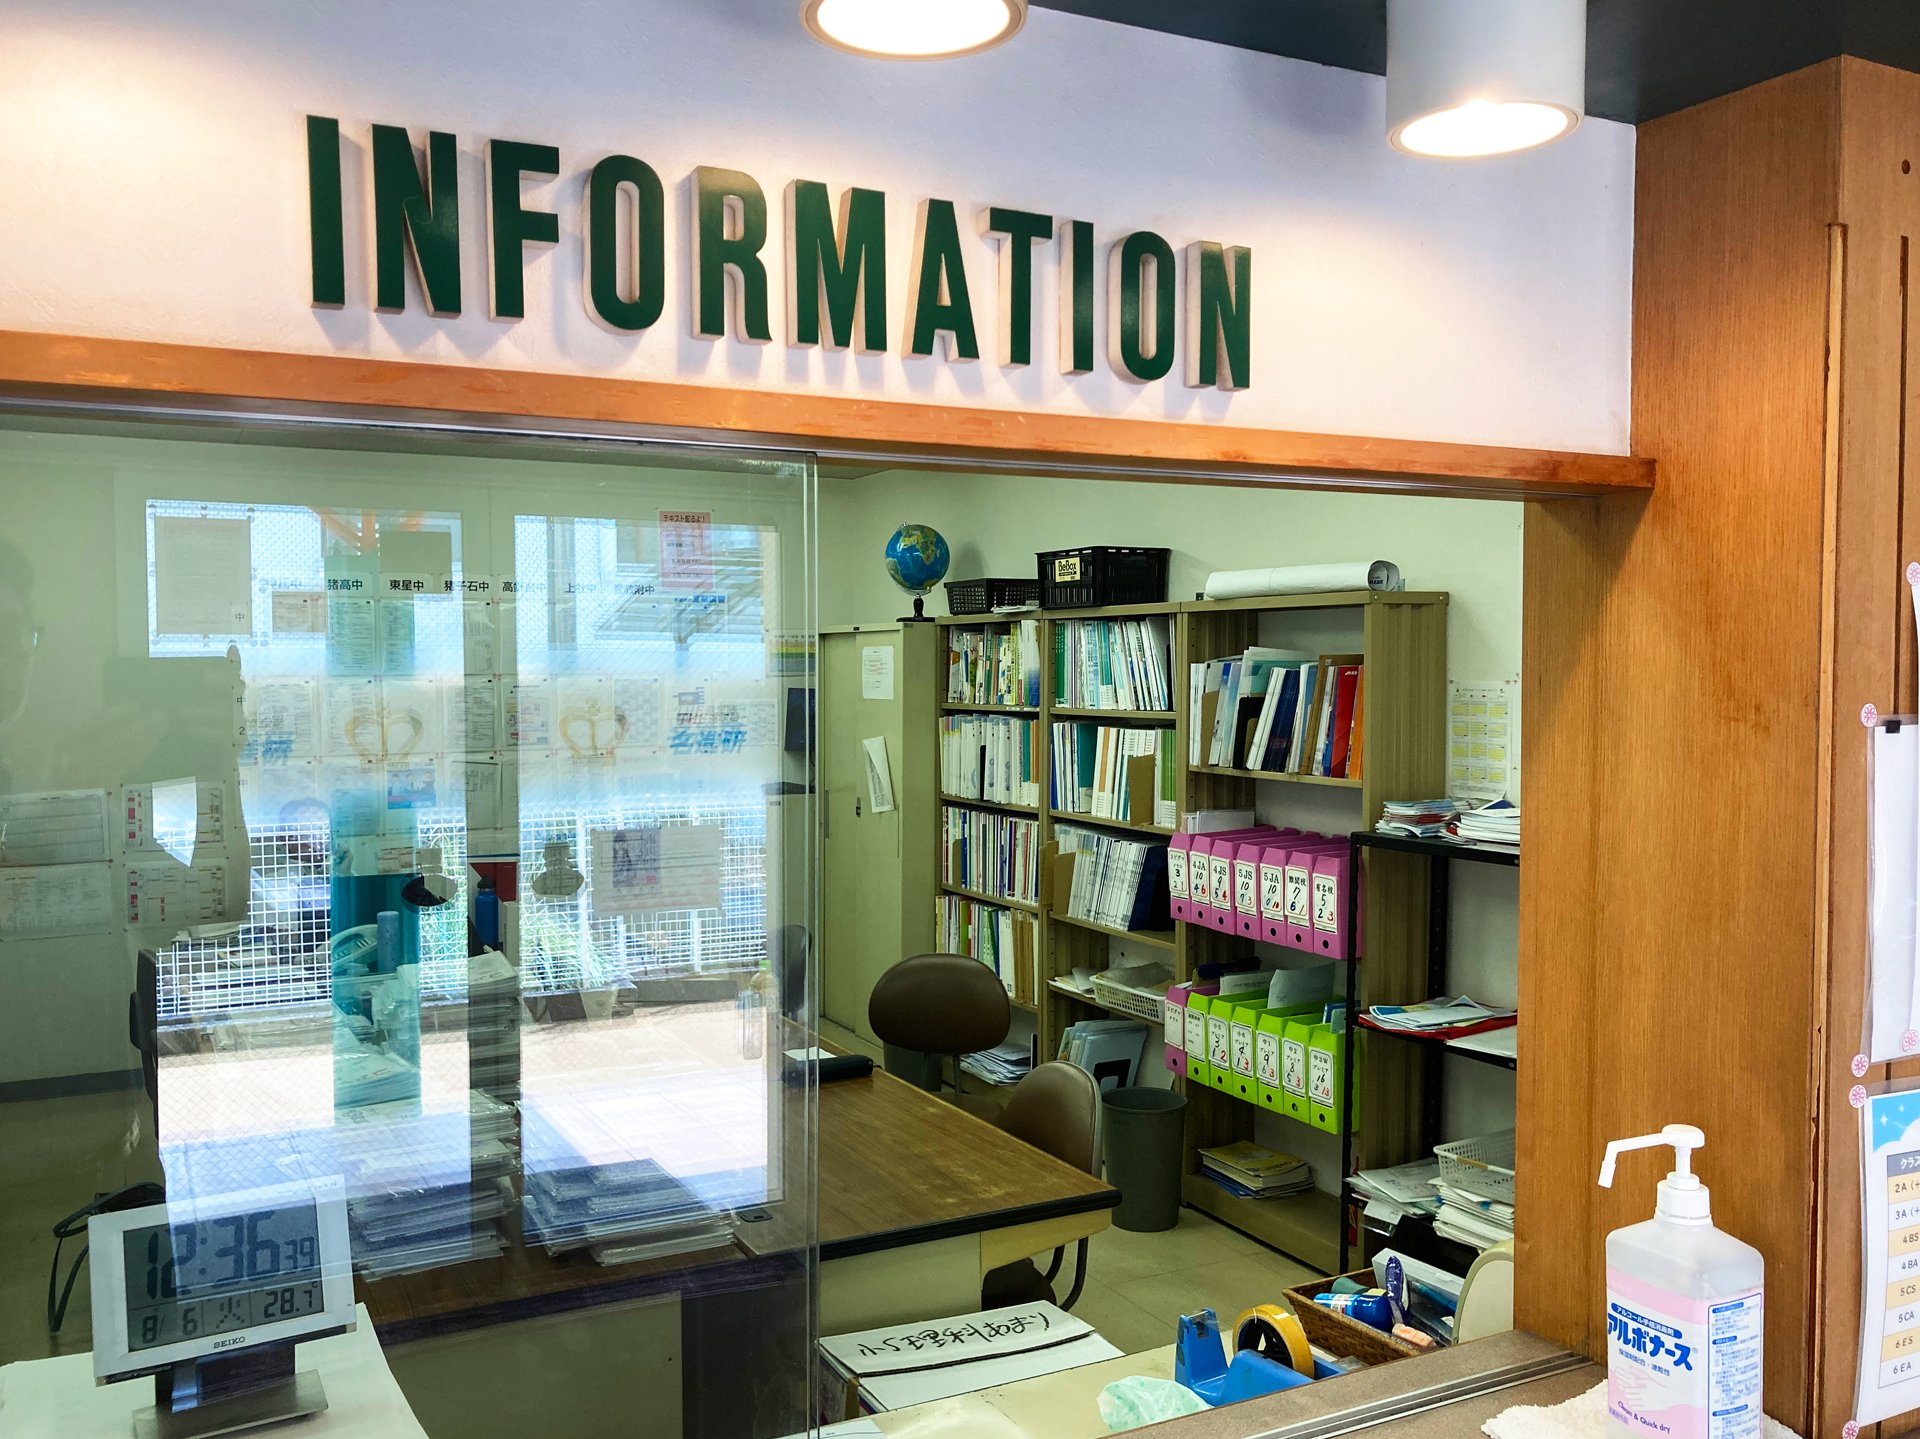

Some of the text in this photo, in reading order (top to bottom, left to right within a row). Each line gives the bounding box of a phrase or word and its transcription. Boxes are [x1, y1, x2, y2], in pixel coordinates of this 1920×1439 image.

[306, 115, 1252, 391] INFORMATION
[1058, 560, 1077, 571] BeBox
[328, 578, 363, 591] 猪高中
[390, 579, 424, 591] 東星中
[444, 580, 490, 592] 猪子石中
[1175, 869, 1180, 877] 3
[1195, 871, 1203, 880] 10
[1217, 876, 1222, 888] 9
[1241, 881, 1249, 891] 10
[1194, 883, 1206, 894] 4 6
[1215, 888, 1227, 901] 5 4
[1268, 884, 1277, 894] 10
[1293, 886, 1301, 900] 7
[1248, 896, 1252, 905] 3
[1290, 901, 1296, 911] 6
[1321, 893, 1326, 907] 5
[1318, 908, 1334, 921] 2 3
[1215, 1036, 1220, 1048] 3
[1220, 1050, 1227, 1063] 2
[1264, 1054, 1269, 1065] 9
[1269, 1068, 1275, 1078] 3
[1290, 1062, 1295, 1073] 8
[1296, 1076, 1301, 1087] 3
[1316, 1073, 1325, 1083] 16
[1321, 1086, 1330, 1097] 13
[147, 1210, 315, 1300] 12:36 39
[215, 1297, 246, 1328] 火
[264, 1288, 313, 1318] 28.7
[213, 1336, 246, 1349] SEIKO
[1608, 1312, 1693, 1371] アルボナース
[1617, 1400, 1633, 1417] Clean
[1634, 1413, 1639, 1421] &
[1640, 1416, 1658, 1429] Quick
[1659, 1423, 1671, 1435] dry
